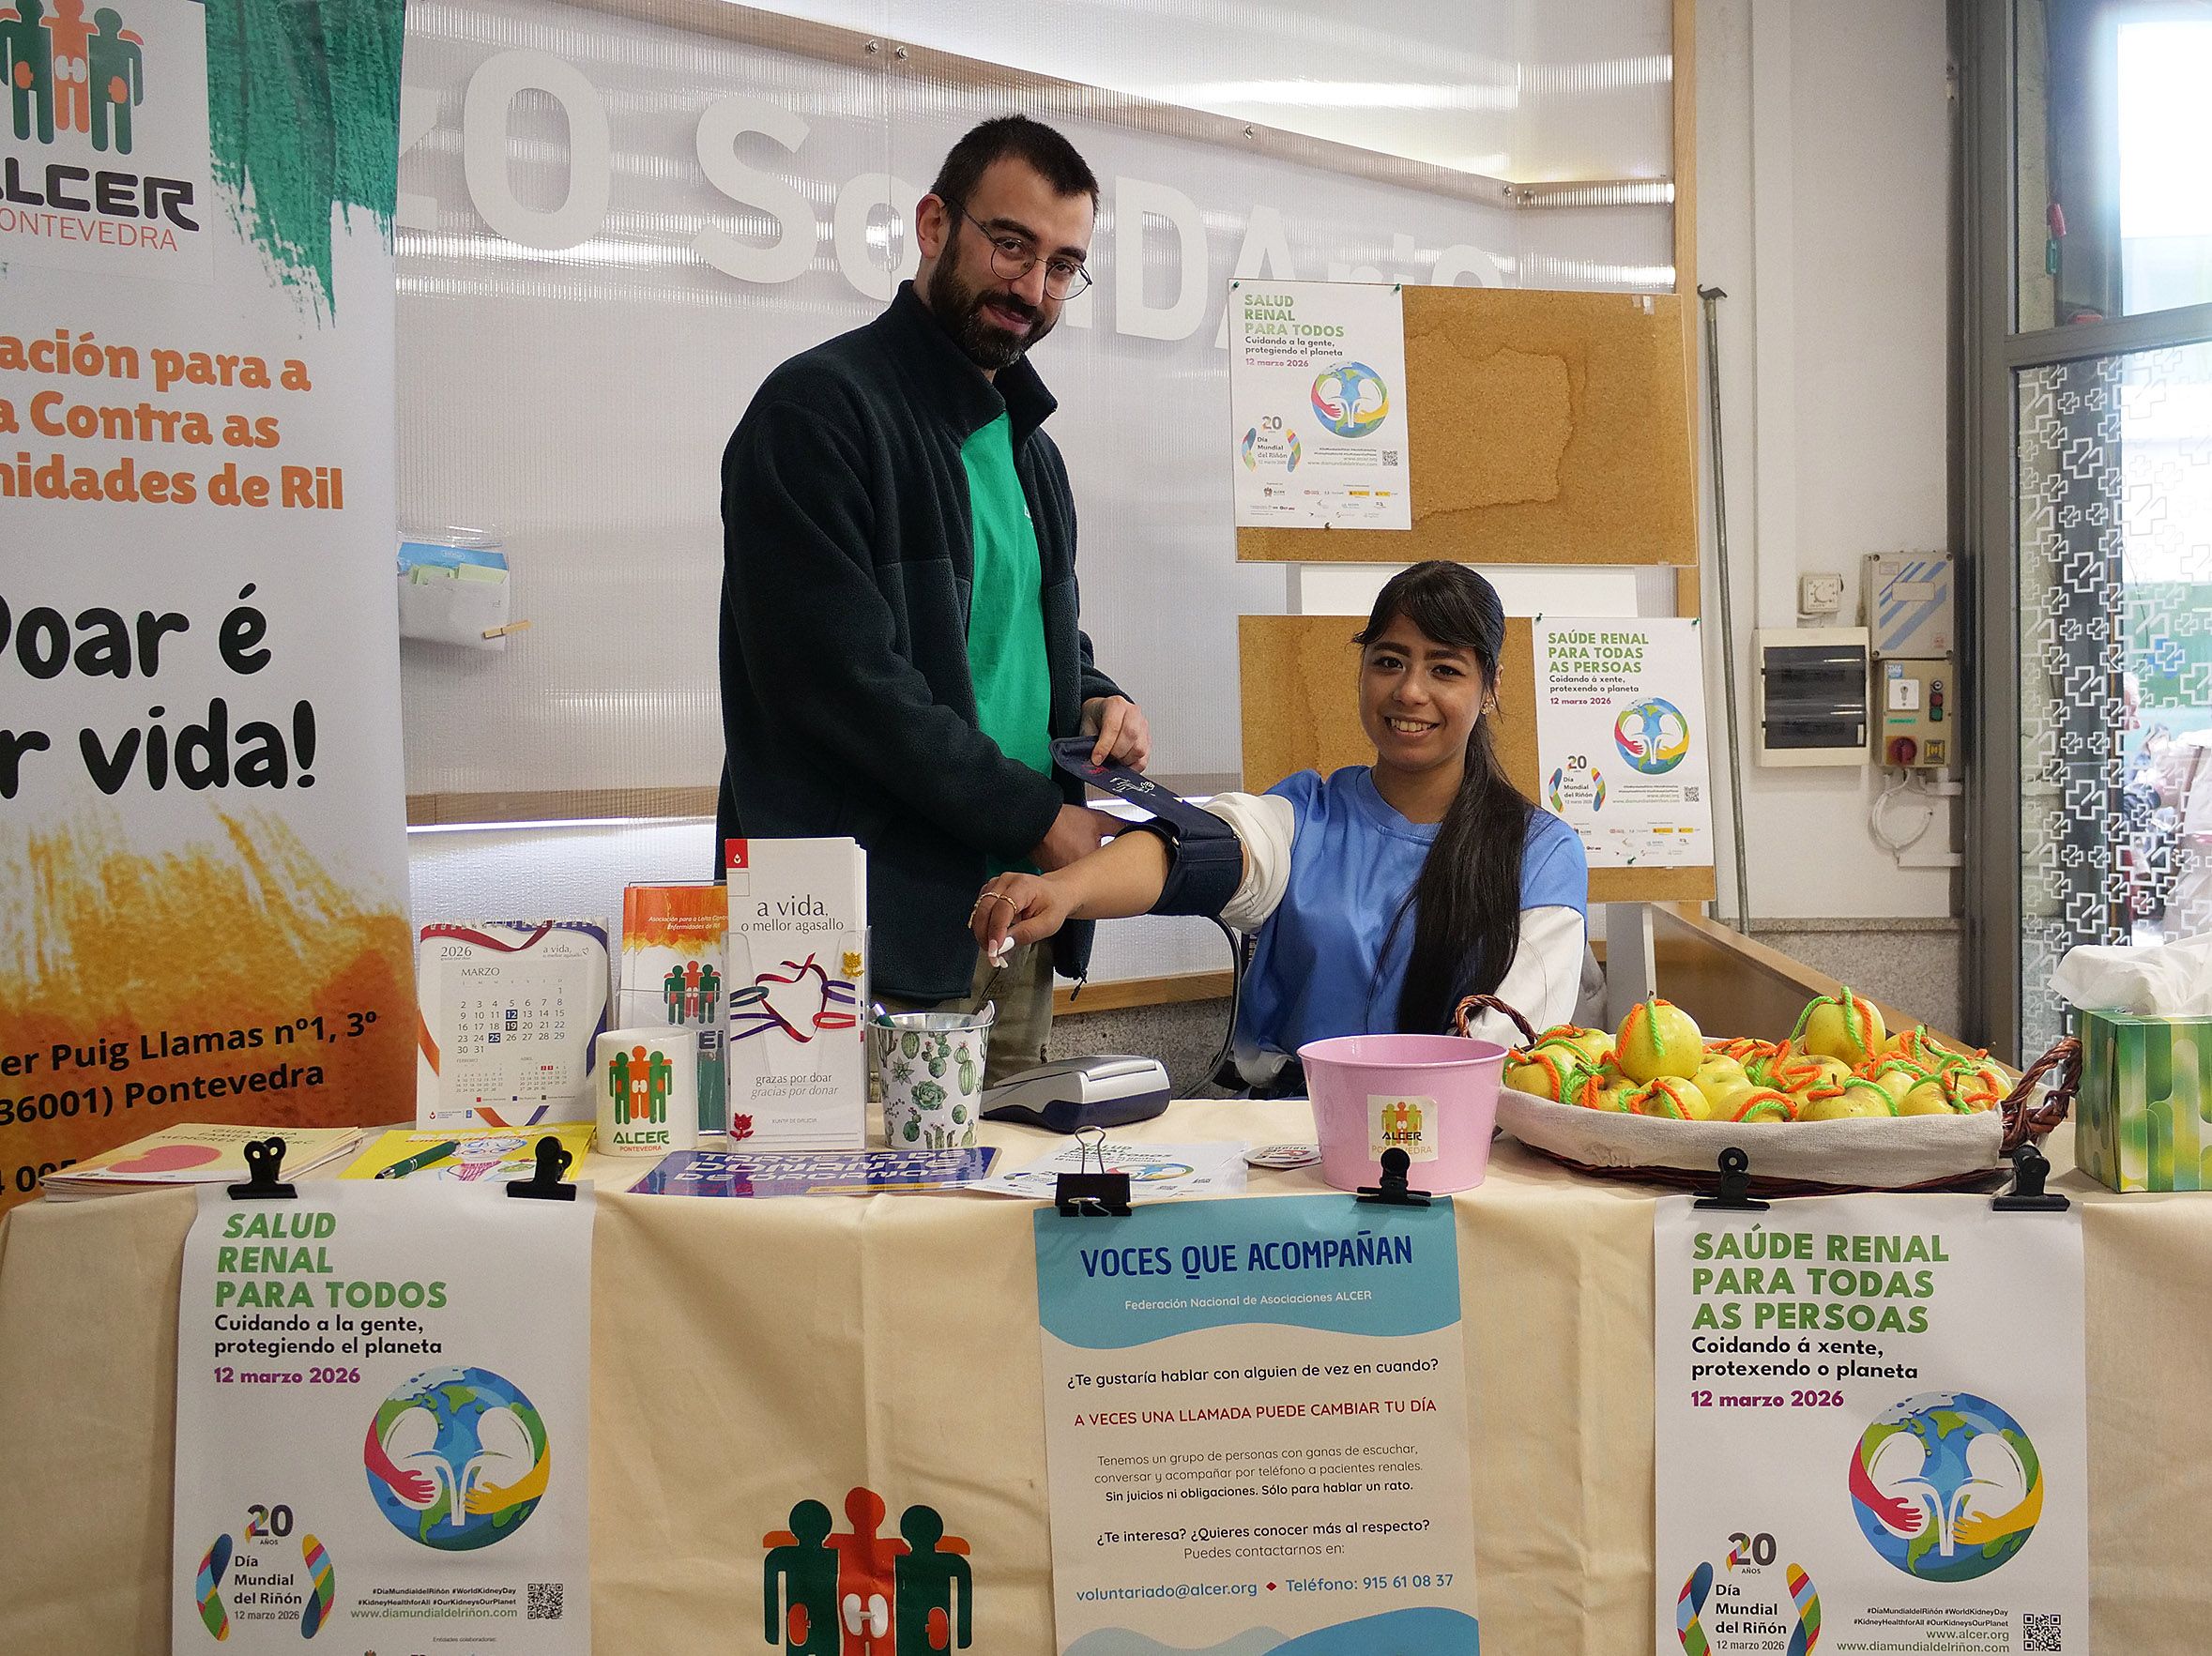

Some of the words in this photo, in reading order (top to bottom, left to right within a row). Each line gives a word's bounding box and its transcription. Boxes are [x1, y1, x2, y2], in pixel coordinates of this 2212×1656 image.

[0, 158, 199, 232] LCER
[1244, 295, 1293, 307] SALUD
[1244, 309, 1295, 322] RENAL
[1245, 323, 1288, 336] PARA
[1293, 325, 1344, 338] TODOS
[1245, 337, 1287, 346] Cuidando
[1308, 339, 1335, 348] gente,
[0, 328, 139, 380] ación
[151, 348, 270, 392] para
[281, 359, 312, 391] a
[1246, 347, 1297, 356] protegiendo
[1310, 348, 1342, 357] planeta
[30, 391, 213, 445] Contra
[222, 416, 281, 448] as
[207, 463, 269, 508] de
[282, 466, 343, 509] Ril
[0, 594, 190, 679] oar
[219, 583, 271, 675] é
[1548, 630, 1595, 645] SAÚDE
[1601, 633, 1649, 645] RENAL
[1548, 647, 1589, 659] PARA
[1594, 647, 1643, 659] TODAS
[1549, 661, 1569, 673] AS
[1574, 661, 1641, 673] PERSOAS
[1600, 676, 1625, 684] xente,
[1550, 685, 1597, 693] protexendo
[1608, 685, 1639, 693] planeta
[79, 697, 316, 795] vida!
[1567, 755, 1587, 770] 20
[757, 901, 769, 917] a
[741, 922, 749, 931] o
[753, 919, 791, 932] mellor
[796, 919, 844, 934] agasallo
[441, 947, 472, 957] 2026
[462, 968, 499, 977] MARZO
[52, 1039, 129, 1071] Puig
[141, 1027, 264, 1060] Llamas
[126, 1063, 324, 1108] Pontevedra
[756, 1074, 787, 1086] grazas
[790, 1074, 807, 1086] por
[810, 1072, 831, 1083] doar
[751, 1087, 786, 1100] gracias
[789, 1088, 807, 1099] por
[809, 1086, 839, 1096] donar
[614, 1131, 670, 1144] ALCER
[1382, 1132, 1422, 1141] ALCER
[222, 1212, 337, 1239] SALUD
[1693, 1223, 1813, 1260] SAÚDE
[1826, 1234, 1949, 1262] RENAL
[217, 1246, 334, 1273] RENAL
[1080, 1246, 1172, 1278] VOCES
[1182, 1244, 1238, 1280] QUE
[1247, 1230, 1412, 1271] ACOMPAÑAN
[1692, 1269, 1794, 1295] PARA
[1807, 1269, 1934, 1299] TODAS
[215, 1282, 314, 1309] PARA
[325, 1282, 448, 1309] TODOS
[1125, 1298, 1187, 1311] Federación
[1191, 1296, 1240, 1307] Nacional
[1243, 1295, 1257, 1305] de
[1260, 1292, 1333, 1305] Asociaciones
[1335, 1291, 1372, 1301] ALCER
[215, 1314, 310, 1332] Cuidando
[317, 1318, 329, 1331] a
[335, 1314, 353, 1331] la
[360, 1317, 423, 1335] gente,
[1691, 1303, 1742, 1330] AS
[1754, 1303, 1929, 1333] PERSOAS
[214, 1337, 335, 1358] protegiendo
[342, 1337, 358, 1354] el
[365, 1337, 442, 1358] planeta
[1691, 1336, 1791, 1354] Coidando
[1797, 1337, 1810, 1353] á
[1818, 1339, 1884, 1358] xente,
[214, 1367, 234, 1383] 12
[240, 1371, 303, 1383] marzo
[310, 1367, 360, 1383] 2026
[1067, 1375, 1091, 1390] ¿Te
[1096, 1370, 1157, 1388] gustaría
[1161, 1368, 1209, 1382] hablar
[1213, 1368, 1240, 1380] con
[1243, 1364, 1297, 1380] alguien
[1302, 1363, 1320, 1376] de
[1324, 1364, 1350, 1375] vez
[1353, 1362, 1371, 1374] en
[1376, 1358, 1439, 1373] cuando?
[1691, 1360, 1810, 1380] protexendo
[1817, 1364, 1830, 1377] o
[1837, 1360, 1918, 1381] planeta
[1691, 1390, 1712, 1406] 12
[1719, 1395, 1784, 1407] marzo
[1791, 1390, 1844, 1407] 2026
[1075, 1414, 1085, 1427] A
[1089, 1411, 1137, 1425] VECES
[1142, 1409, 1175, 1422] UNA
[1179, 1406, 1252, 1421] LLAMADA
[1256, 1405, 1305, 1418] PUEDE
[1310, 1402, 1380, 1417] CAMBIAR
[1384, 1400, 1405, 1413] TU
[1411, 1397, 1437, 1412] DÍA
[1726, 1532, 1777, 1572] 20
[235, 1556, 258, 1568] Día
[235, 1573, 294, 1586] Mundial
[1076, 1581, 1258, 1602] voluntariado@alcer.org
[1286, 1577, 1358, 1593] Teléfono:
[1363, 1576, 1387, 1590] 915
[1393, 1575, 1408, 1588] 61
[1412, 1574, 1431, 1588] 08
[1436, 1573, 1454, 1587] 37
[235, 1592, 255, 1604] del
[260, 1591, 302, 1604] Riñón
[1716, 1585, 1740, 1596] Día
[1716, 1603, 1777, 1616] Mundial
[1716, 1621, 1738, 1633] del
[1743, 1621, 1787, 1634] Riñón
[1926, 1630, 2009, 1641] www.alcer.org
[1838, 1642, 2009, 1652] www.diamundialdelriñon.com
